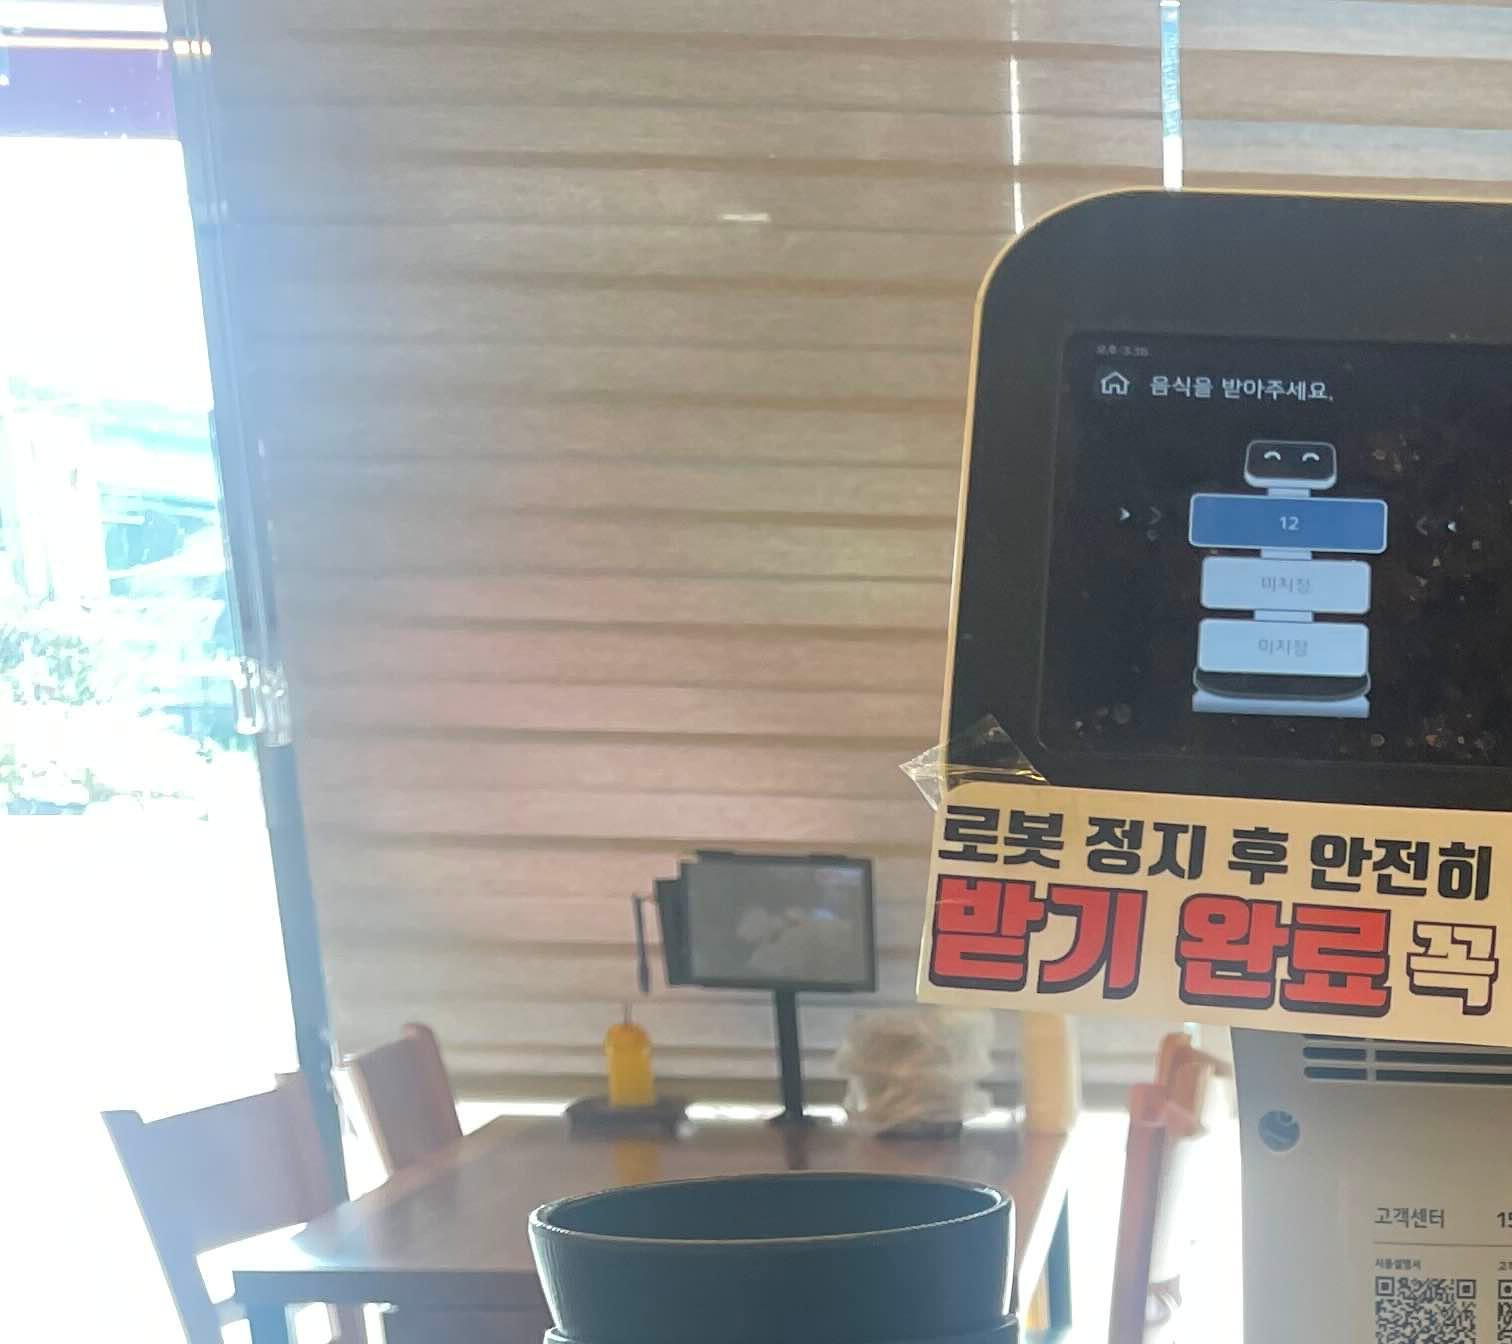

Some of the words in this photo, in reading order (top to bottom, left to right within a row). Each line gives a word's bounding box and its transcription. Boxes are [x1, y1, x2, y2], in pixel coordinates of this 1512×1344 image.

[1150, 376, 1213, 398] 음식을
[1222, 378, 1335, 401] 받아주세요.
[1280, 515, 1300, 531] 12
[937, 804, 1064, 869] 로봇
[1085, 816, 1208, 880] 정지
[1228, 826, 1290, 885] 후
[1310, 833, 1493, 900] 안전히
[928, 873, 1148, 1000] 받기
[1174, 892, 1392, 1018] 완료
[1406, 919, 1498, 1016] 꼭
[1374, 1207, 1446, 1229] 고객센터
